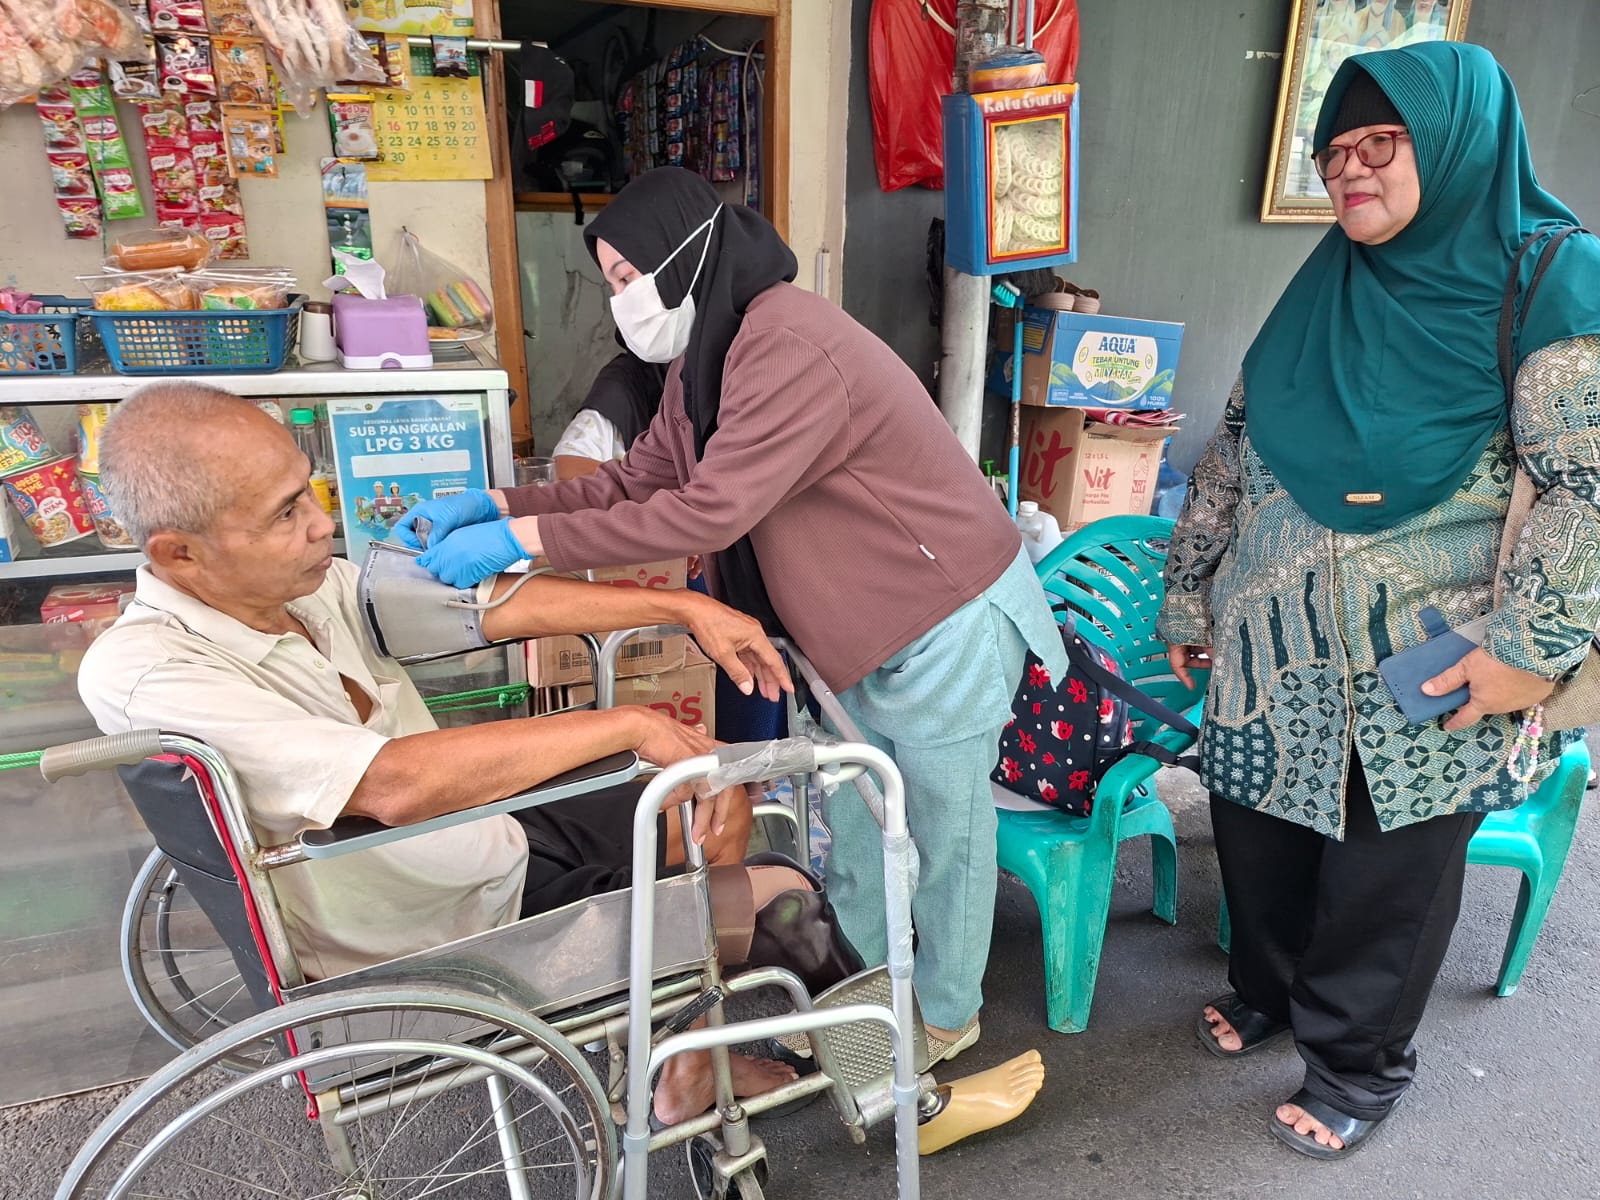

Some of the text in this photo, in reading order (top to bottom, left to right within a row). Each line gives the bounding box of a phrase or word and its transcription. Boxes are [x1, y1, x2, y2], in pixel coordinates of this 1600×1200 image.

[423, 89, 432, 101] 4
[442, 89, 450, 100] 5
[461, 91, 469, 101] 6
[1022, 90, 1067, 109] Gurih
[387, 105, 473, 116] 9 10 11 12 13
[387, 121, 401, 131] 16
[406, 121, 419, 131] 17
[425, 121, 438, 131] 18
[443, 121, 457, 131] 19
[462, 121, 476, 131] 20
[389, 136, 403, 147] 23
[408, 136, 422, 147] 24
[427, 136, 441, 147] 25
[446, 136, 459, 147] 26
[464, 136, 477, 147] 27
[391, 151, 406, 162] 30
[1098, 336, 1136, 355] AQUA
[1091, 356, 1140, 368] TEBAR UNTUNG
[349, 421, 467, 438] SUB PANGKALAN
[365, 434, 456, 452] LPG 3 KG
[1084, 466, 1116, 490] Vit
[43, 500, 65, 514] AYAM
